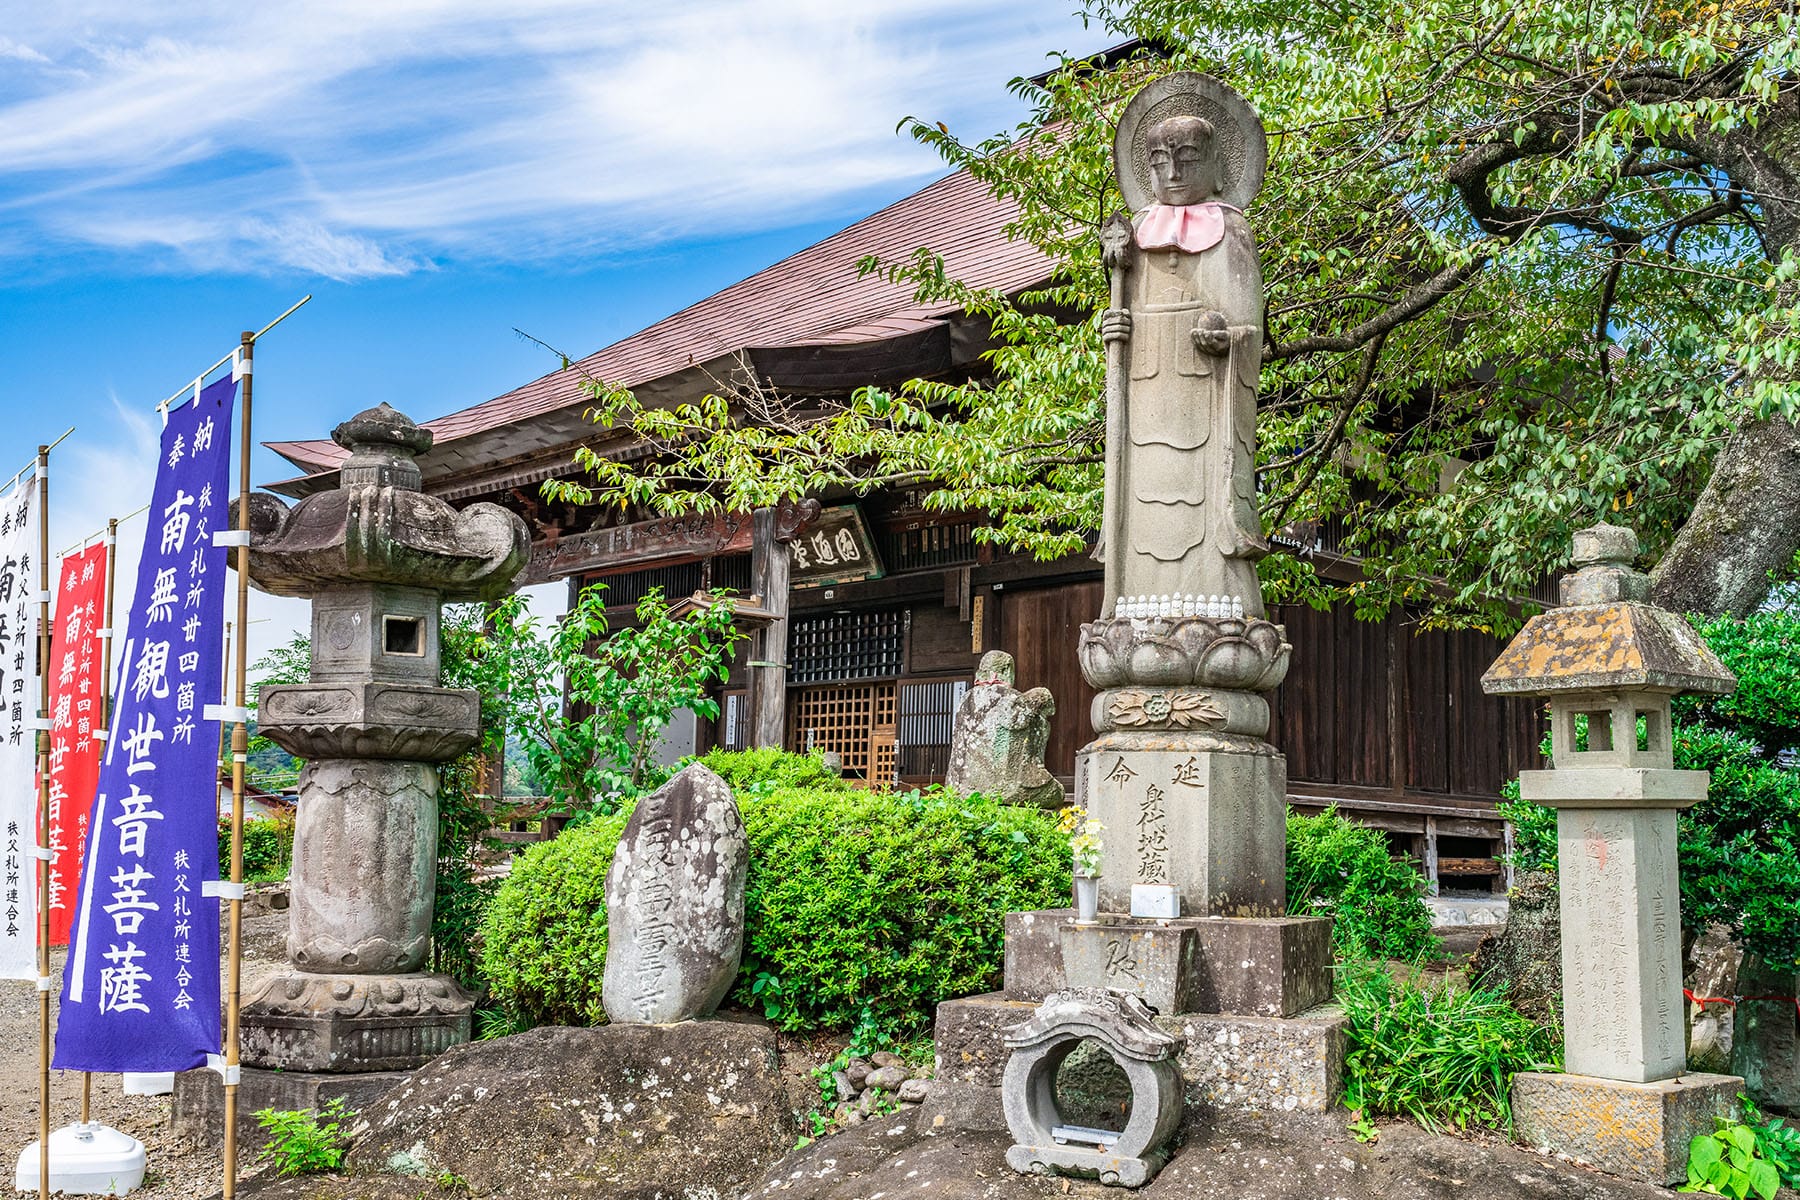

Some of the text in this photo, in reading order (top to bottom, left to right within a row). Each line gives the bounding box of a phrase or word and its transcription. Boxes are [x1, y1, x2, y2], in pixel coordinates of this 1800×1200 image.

[167, 415, 214, 470] 奉納
[1, 500, 28, 538] 奉納
[65, 559, 95, 593] 奉納
[5, 821, 20, 938] 秩父札所連合会
[172, 849, 195, 1011] 秩父札所連合会
